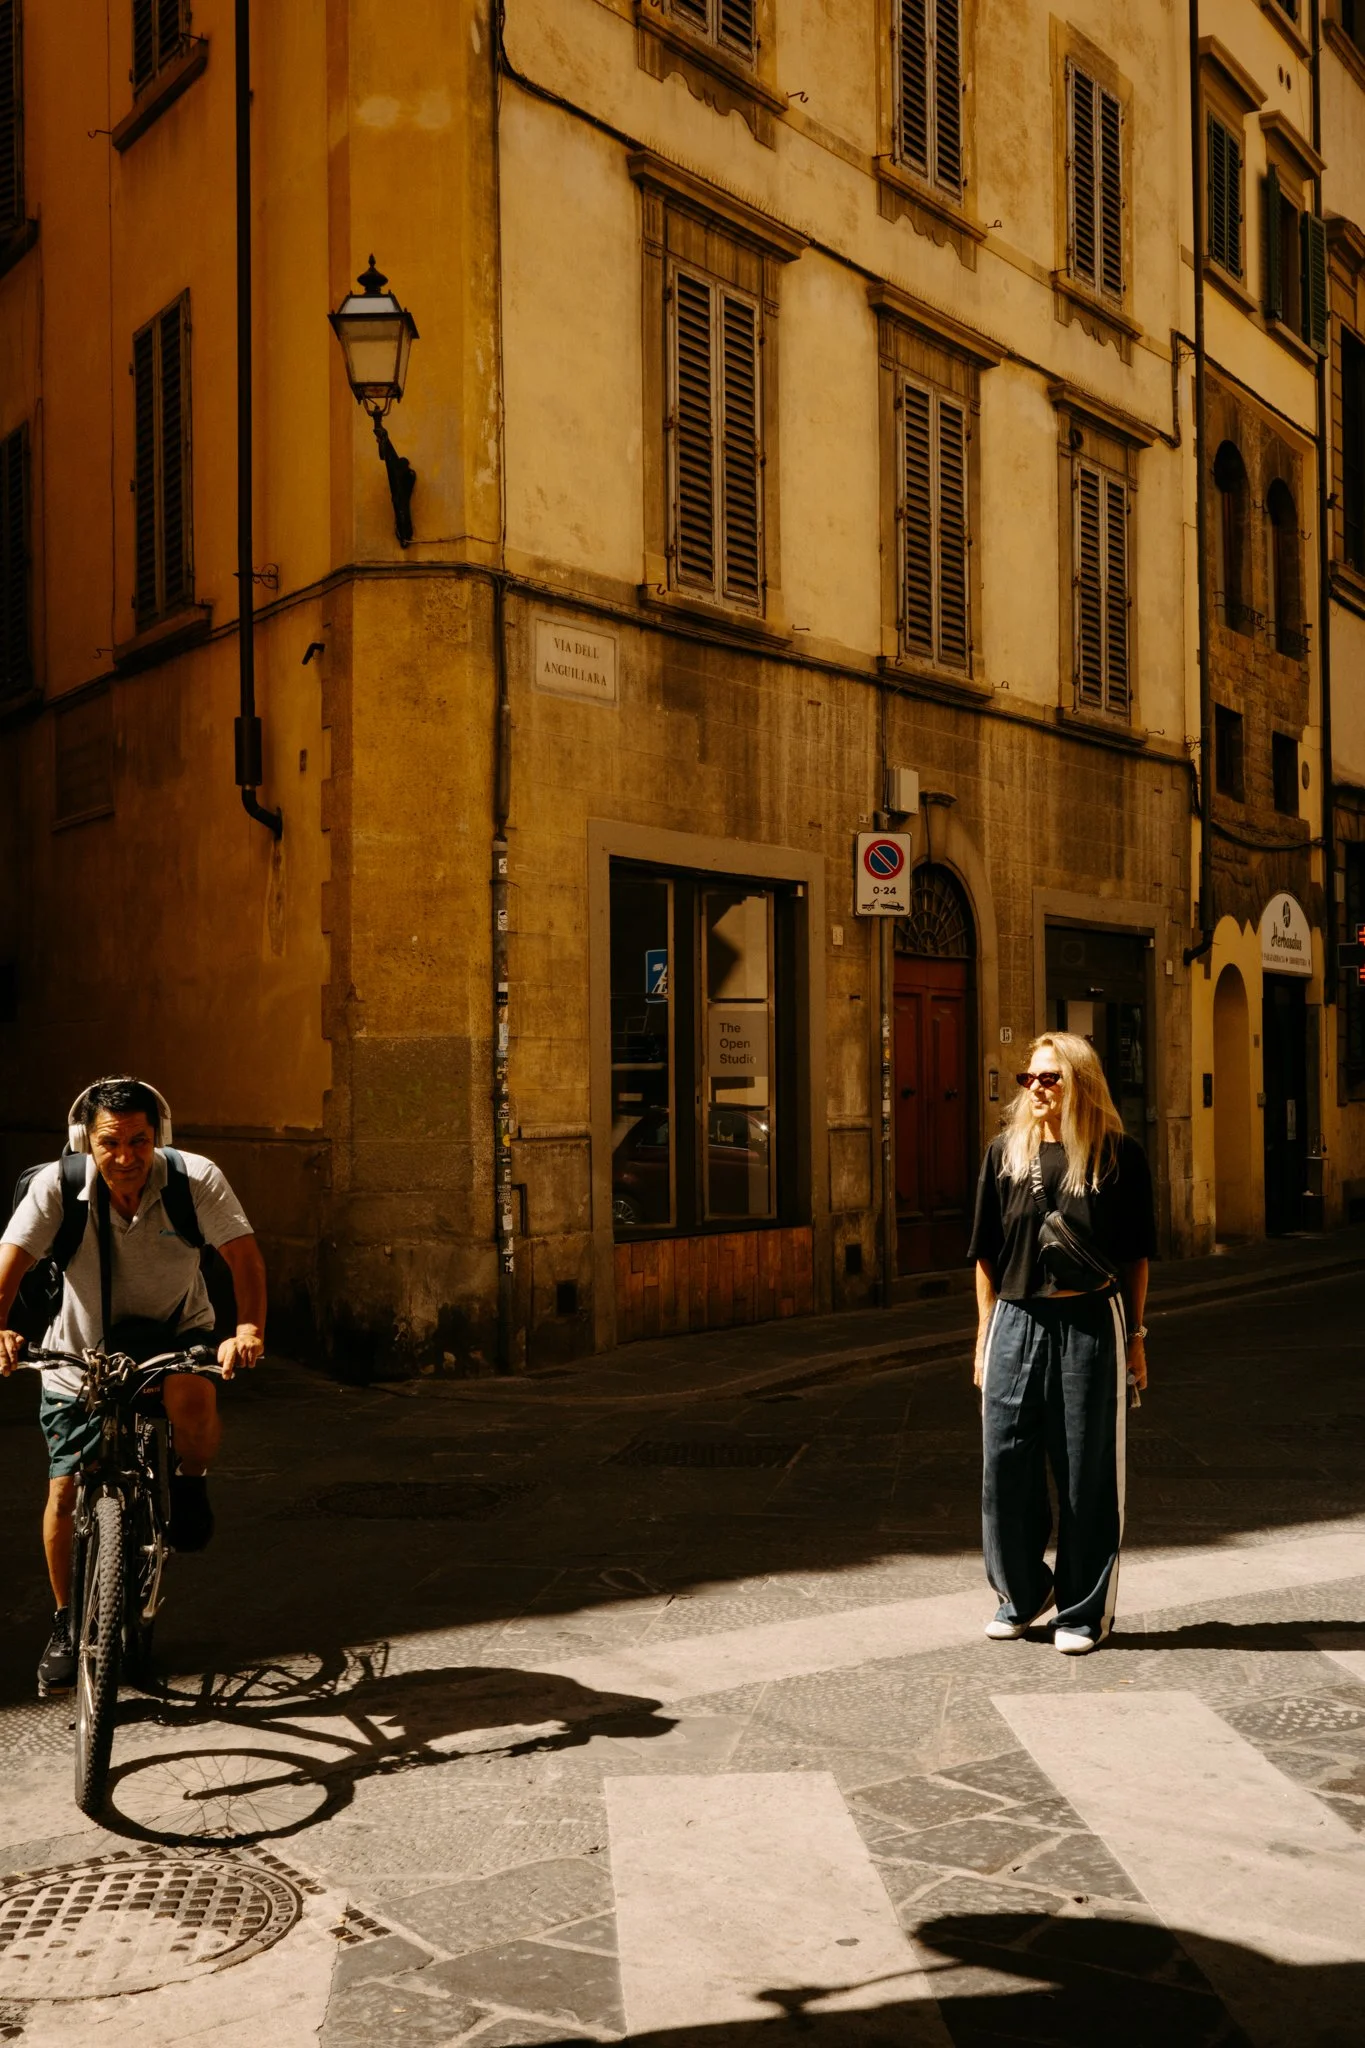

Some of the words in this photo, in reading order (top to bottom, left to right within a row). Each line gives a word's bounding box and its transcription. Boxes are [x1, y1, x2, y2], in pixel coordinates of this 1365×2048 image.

[553, 637, 572, 653] VIA
[544, 661, 607, 686] ANGUILLARA
[873, 886, 897, 895] 0-24
[719, 1022, 741, 1033] The
[1003, 1028, 1010, 1041] 15
[719, 1038, 751, 1050] Open
[719, 1053, 757, 1064] Studio
